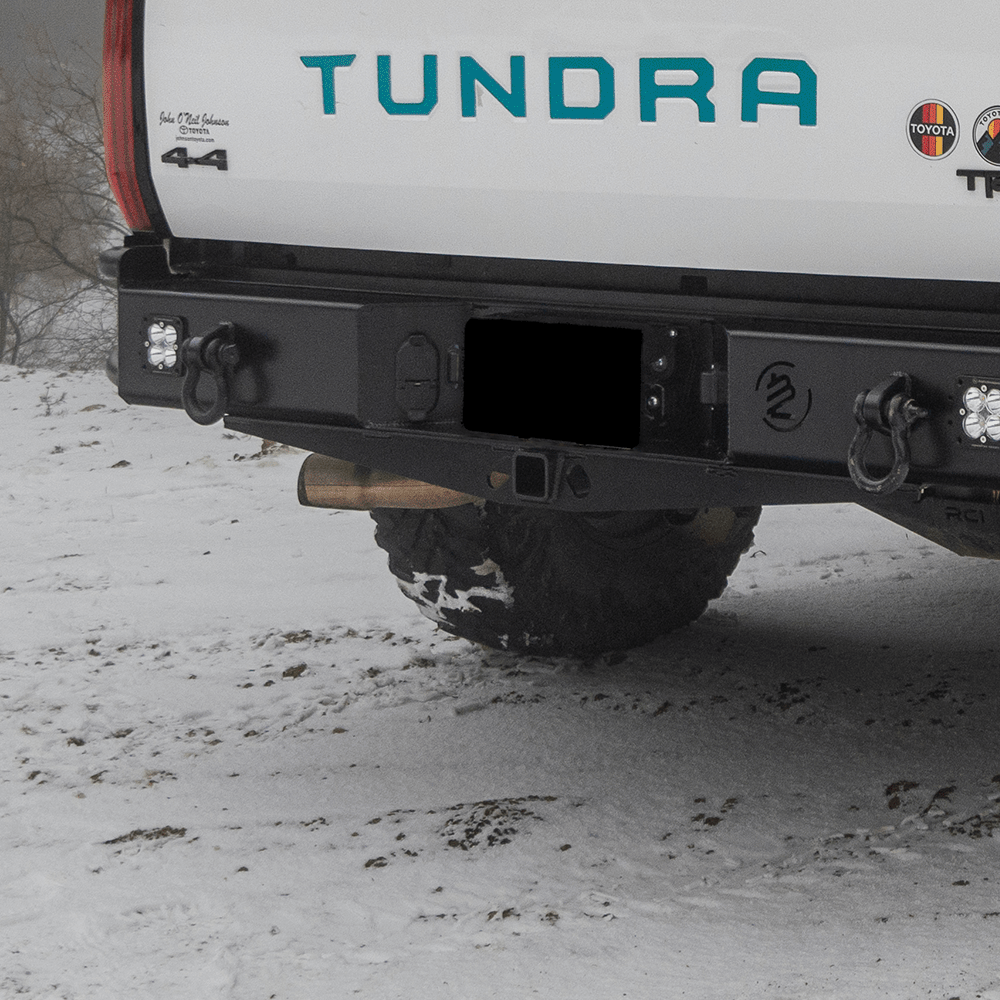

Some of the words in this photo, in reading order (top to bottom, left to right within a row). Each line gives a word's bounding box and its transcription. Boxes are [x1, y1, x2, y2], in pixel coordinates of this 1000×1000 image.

[299, 53, 818, 127] TUNDRA
[188, 127, 210, 135] TOYOTA
[910, 123, 955, 137] TOYOTA
